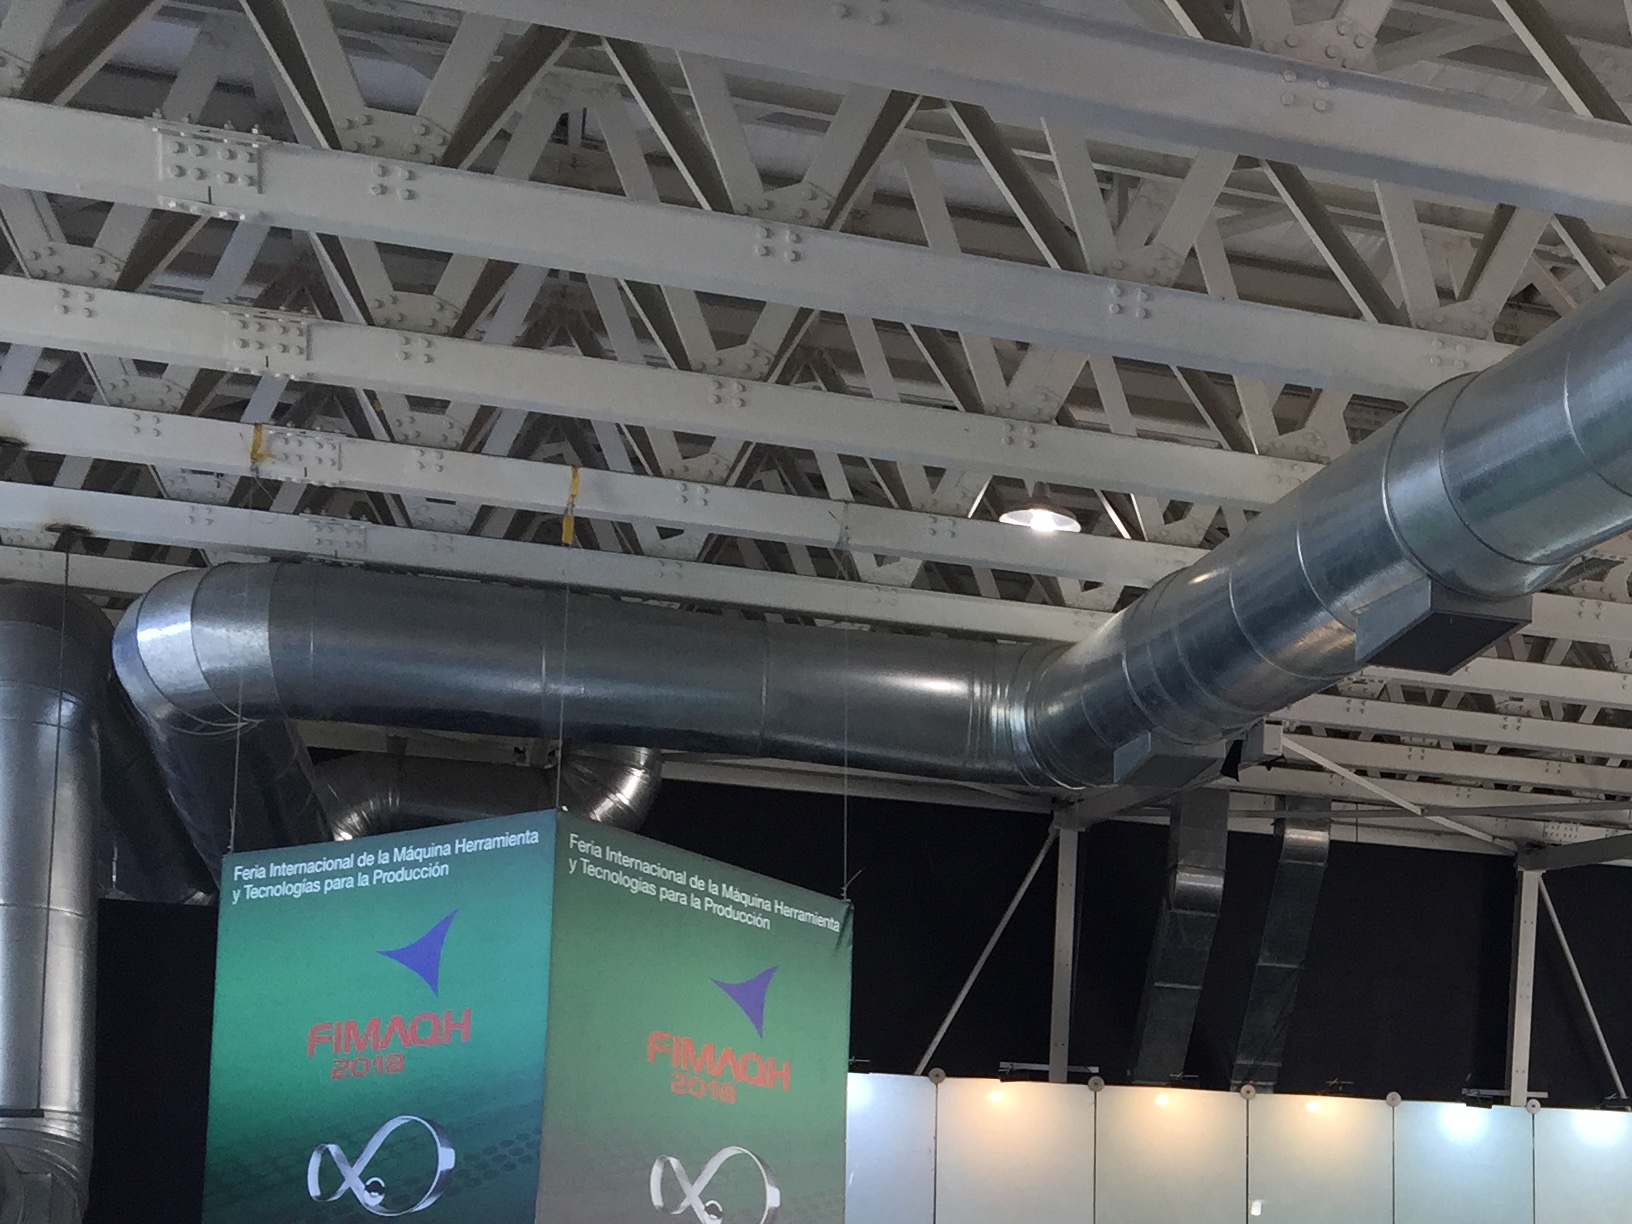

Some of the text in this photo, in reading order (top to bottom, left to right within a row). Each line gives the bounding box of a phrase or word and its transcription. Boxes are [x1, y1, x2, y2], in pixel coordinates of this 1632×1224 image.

[233, 829, 540, 881] Feria Internacional de la Máquina Herramienta
[231, 862, 450, 905] y Tecnologías para la Producción
[568, 857, 771, 931] y Tecnologías para la Producción
[569, 833, 603, 859] Feria
[605, 845, 687, 886] Internacional
[688, 874, 707, 891] de
[708, 879, 720, 896] la
[773, 899, 841, 933] Herramienta
[331, 1053, 405, 1079] 2018
[671, 1072, 737, 1105] 2018
